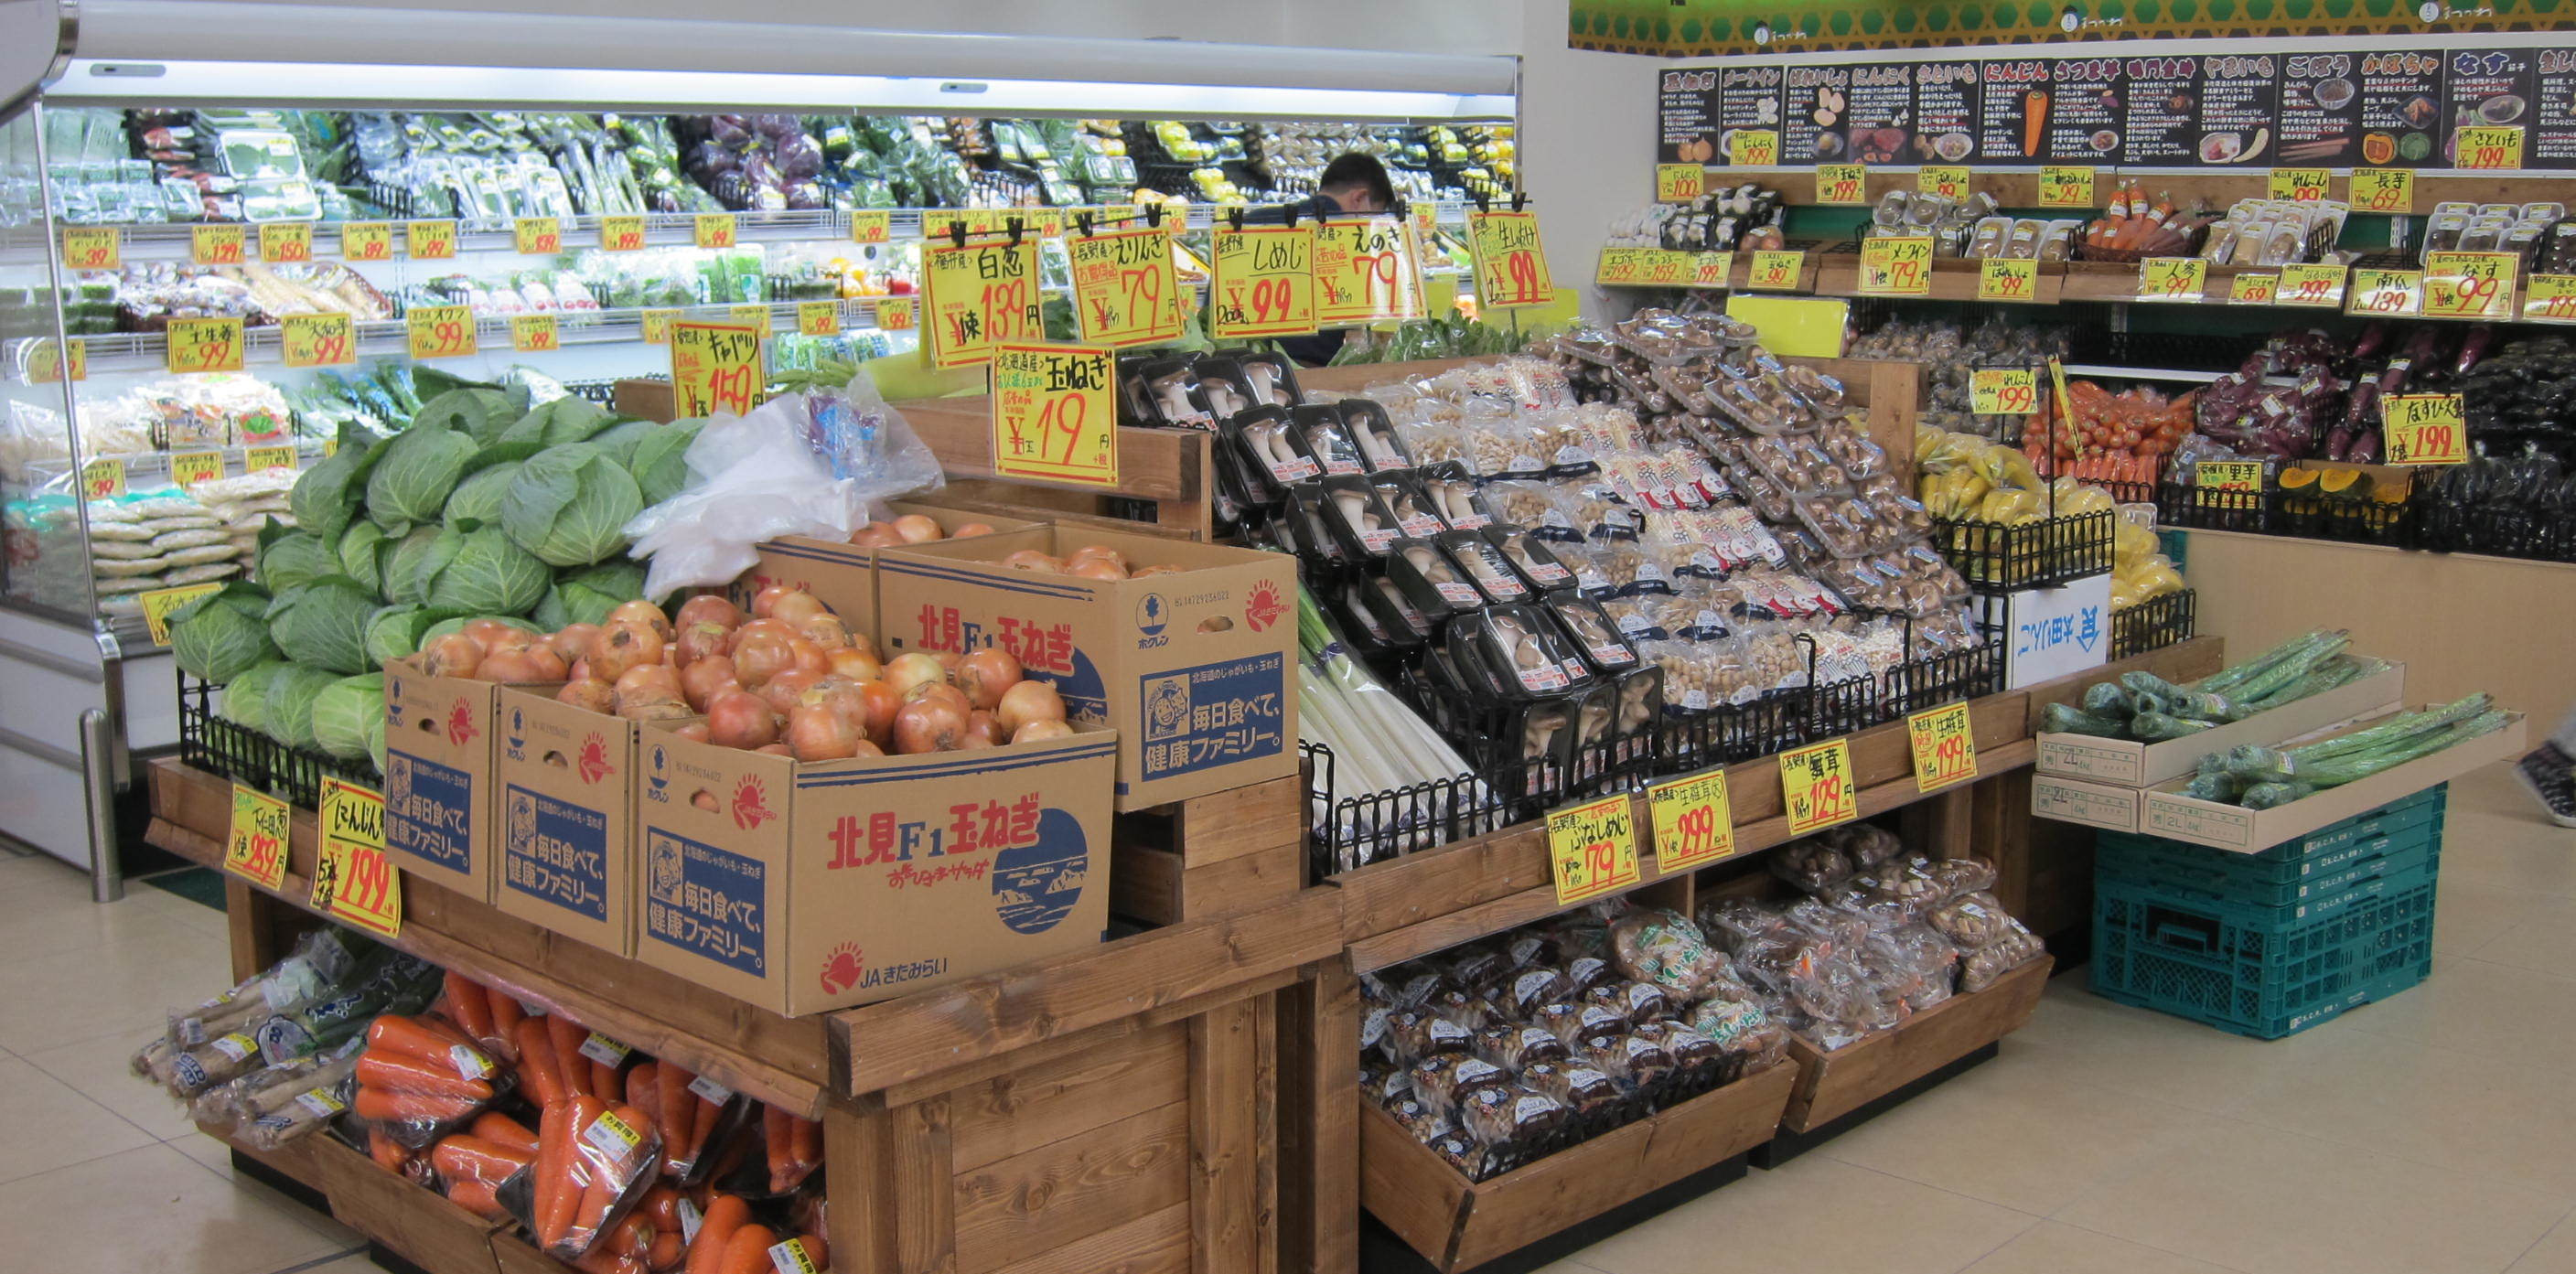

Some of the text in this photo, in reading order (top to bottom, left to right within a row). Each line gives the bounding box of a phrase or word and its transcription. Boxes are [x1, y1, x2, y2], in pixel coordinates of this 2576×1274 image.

[1723, 68, 1781, 88] メークイン
[1852, 66, 1911, 86] にんにく
[1916, 63, 1977, 84] さといも
[1984, 61, 2049, 82] にんじん
[2054, 59, 2121, 81] さつま芋
[2204, 56, 2275, 79] やまいも
[2361, 53, 2439, 75] かぼちゃ
[2453, 51, 2510, 75] なす
[2474, 131, 2517, 148] さといも
[2473, 147, 2505, 168] 199
[1832, 181, 1858, 201] 199
[2375, 172, 2407, 189] 長芋
[2371, 188, 2401, 210] 69
[1115, 235, 1166, 266] えりんぎ
[1253, 237, 1307, 272] しめじ
[1352, 223, 1401, 253] えのき
[1892, 244, 1931, 260] メークイン
[978, 245, 1025, 280] 白葱
[1508, 250, 1539, 304] 99
[1891, 261, 1918, 288] 79
[2461, 261, 2502, 279] なす
[1122, 263, 1161, 335] 79
[1352, 251, 1398, 313] 79
[2002, 277, 2023, 295] 99
[2165, 278, 2191, 298] 99
[2456, 276, 2499, 313] 99
[981, 277, 1025, 344] 139
[1026, 305, 1040, 327] 円
[1252, 277, 1292, 324] 99
[314, 336, 346, 364] 99
[435, 322, 463, 353] 99
[707, 328, 758, 364] キャベツ
[199, 342, 230, 369] 99
[1045, 349, 1112, 392] 玉ねぎ
[708, 364, 751, 417] 159
[1997, 386, 2033, 412] 199
[1036, 392, 1087, 466] 19
[1099, 434, 1111, 449] 円
[2413, 425, 2452, 457] 199
[1138, 636, 1169, 650] ホクレン
[1192, 658, 1281, 684] 北海道のじゃがいも・玉ねぎ
[1192, 691, 1281, 732] 毎日食べて、
[1144, 726, 1281, 774] 健康ファミリー。
[1936, 733, 1964, 778] 199
[411, 794, 468, 837] 毎日食べて、
[1809, 775, 1841, 824] 129
[334, 798, 384, 841] にんじん
[827, 791, 1039, 870] 北見F1玉ねぎ
[1570, 812, 1628, 852] ぶなしめじ
[1678, 804, 1714, 856] 299
[385, 815, 469, 868] 健康ファミリー。
[536, 832, 605, 883] 毎日食べて、
[339, 847, 390, 915] 199
[1584, 840, 1615, 889] 79
[508, 853, 605, 915] 健康ファミリー。
[683, 880, 762, 934] 毎日食べて、
[649, 904, 764, 970] 健康ファミリー。
